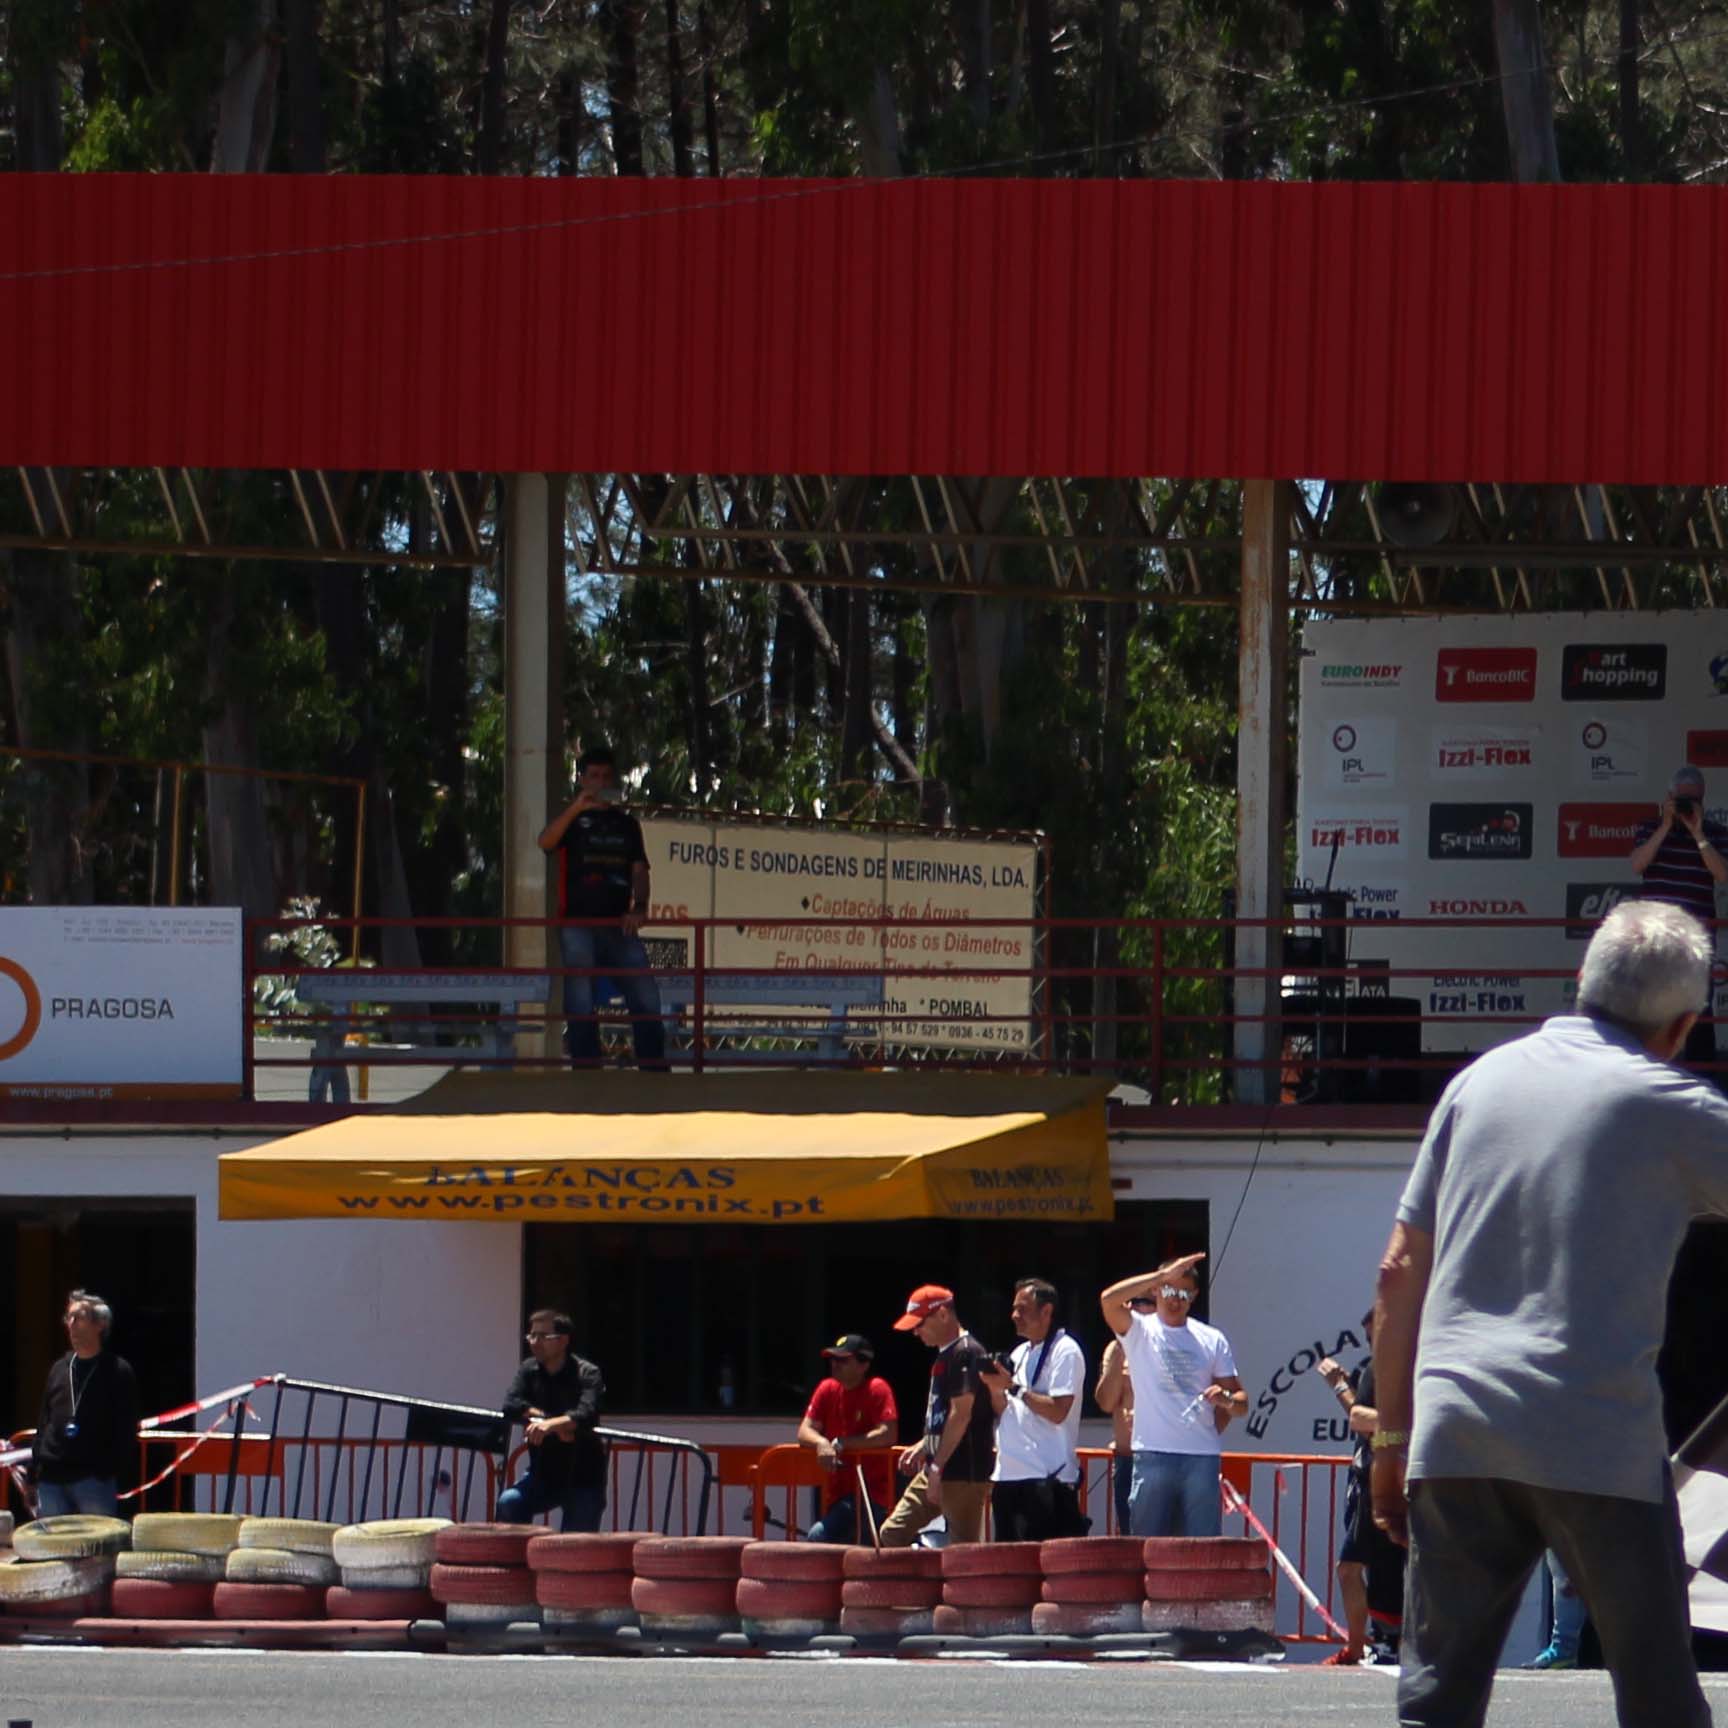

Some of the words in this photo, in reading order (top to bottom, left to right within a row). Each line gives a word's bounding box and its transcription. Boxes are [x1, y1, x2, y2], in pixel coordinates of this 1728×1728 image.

[669, 841, 729, 869] FUROS
[735, 848, 745, 870] E
[749, 850, 858, 878] SONDAGENS
[864, 858, 886, 880] DE
[891, 860, 987, 889] MEIRINHAS,
[992, 867, 1029, 889] LDA.
[1429, 900, 1528, 915] HONDA
[51, 998, 174, 1019] PRAGOSA
[1246, 1329, 1361, 1440] ESCOLA
